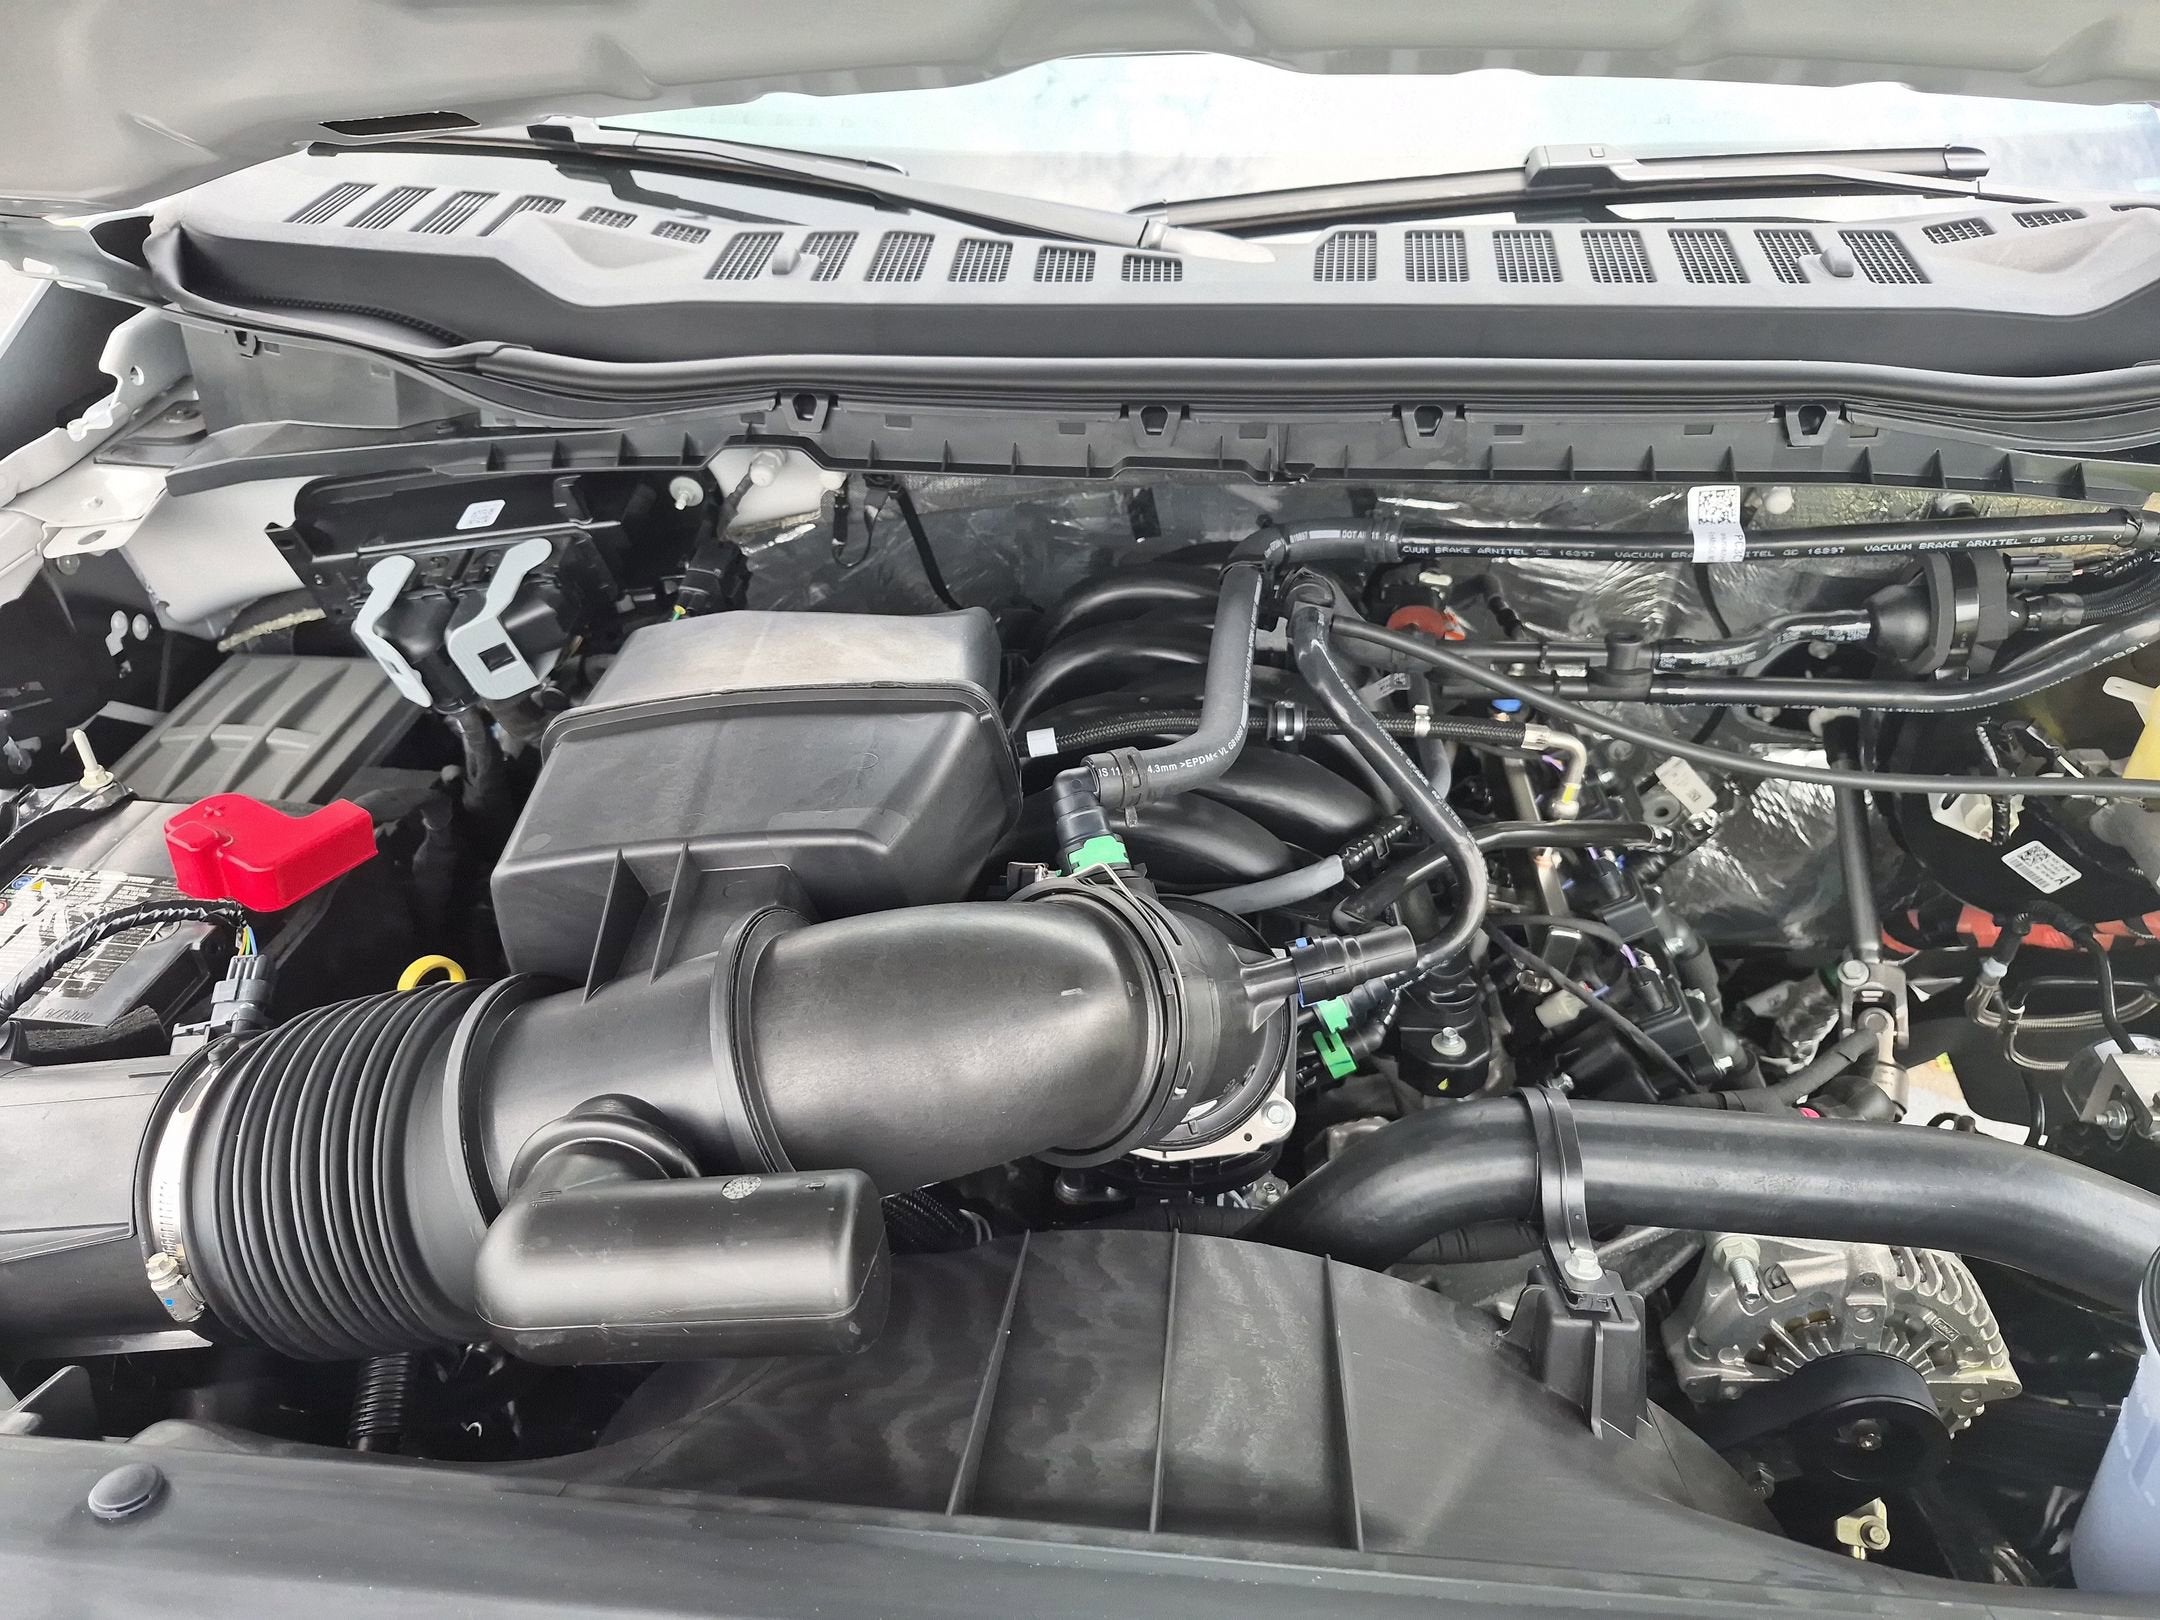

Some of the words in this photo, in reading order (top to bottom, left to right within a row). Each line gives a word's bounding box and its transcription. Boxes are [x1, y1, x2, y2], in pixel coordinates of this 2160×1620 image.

[1402, 545, 1430, 554] CUUM
[1434, 546, 1471, 554] BRAKE
[1477, 547, 1529, 556] ARNITEL
[1614, 551, 1665, 559] VACUUM
[1670, 551, 1694, 559] BRA
[1744, 550, 1776, 558] ITEL
[1863, 543, 1912, 552] VACUUM
[1918, 540, 1960, 549] BRAKE
[1966, 537, 2022, 547] ARNITEL
[1147, 762, 1178, 774] 4.3mm
[1179, 752, 1218, 769] >EPDM<
[1218, 746, 1229, 757] VL
